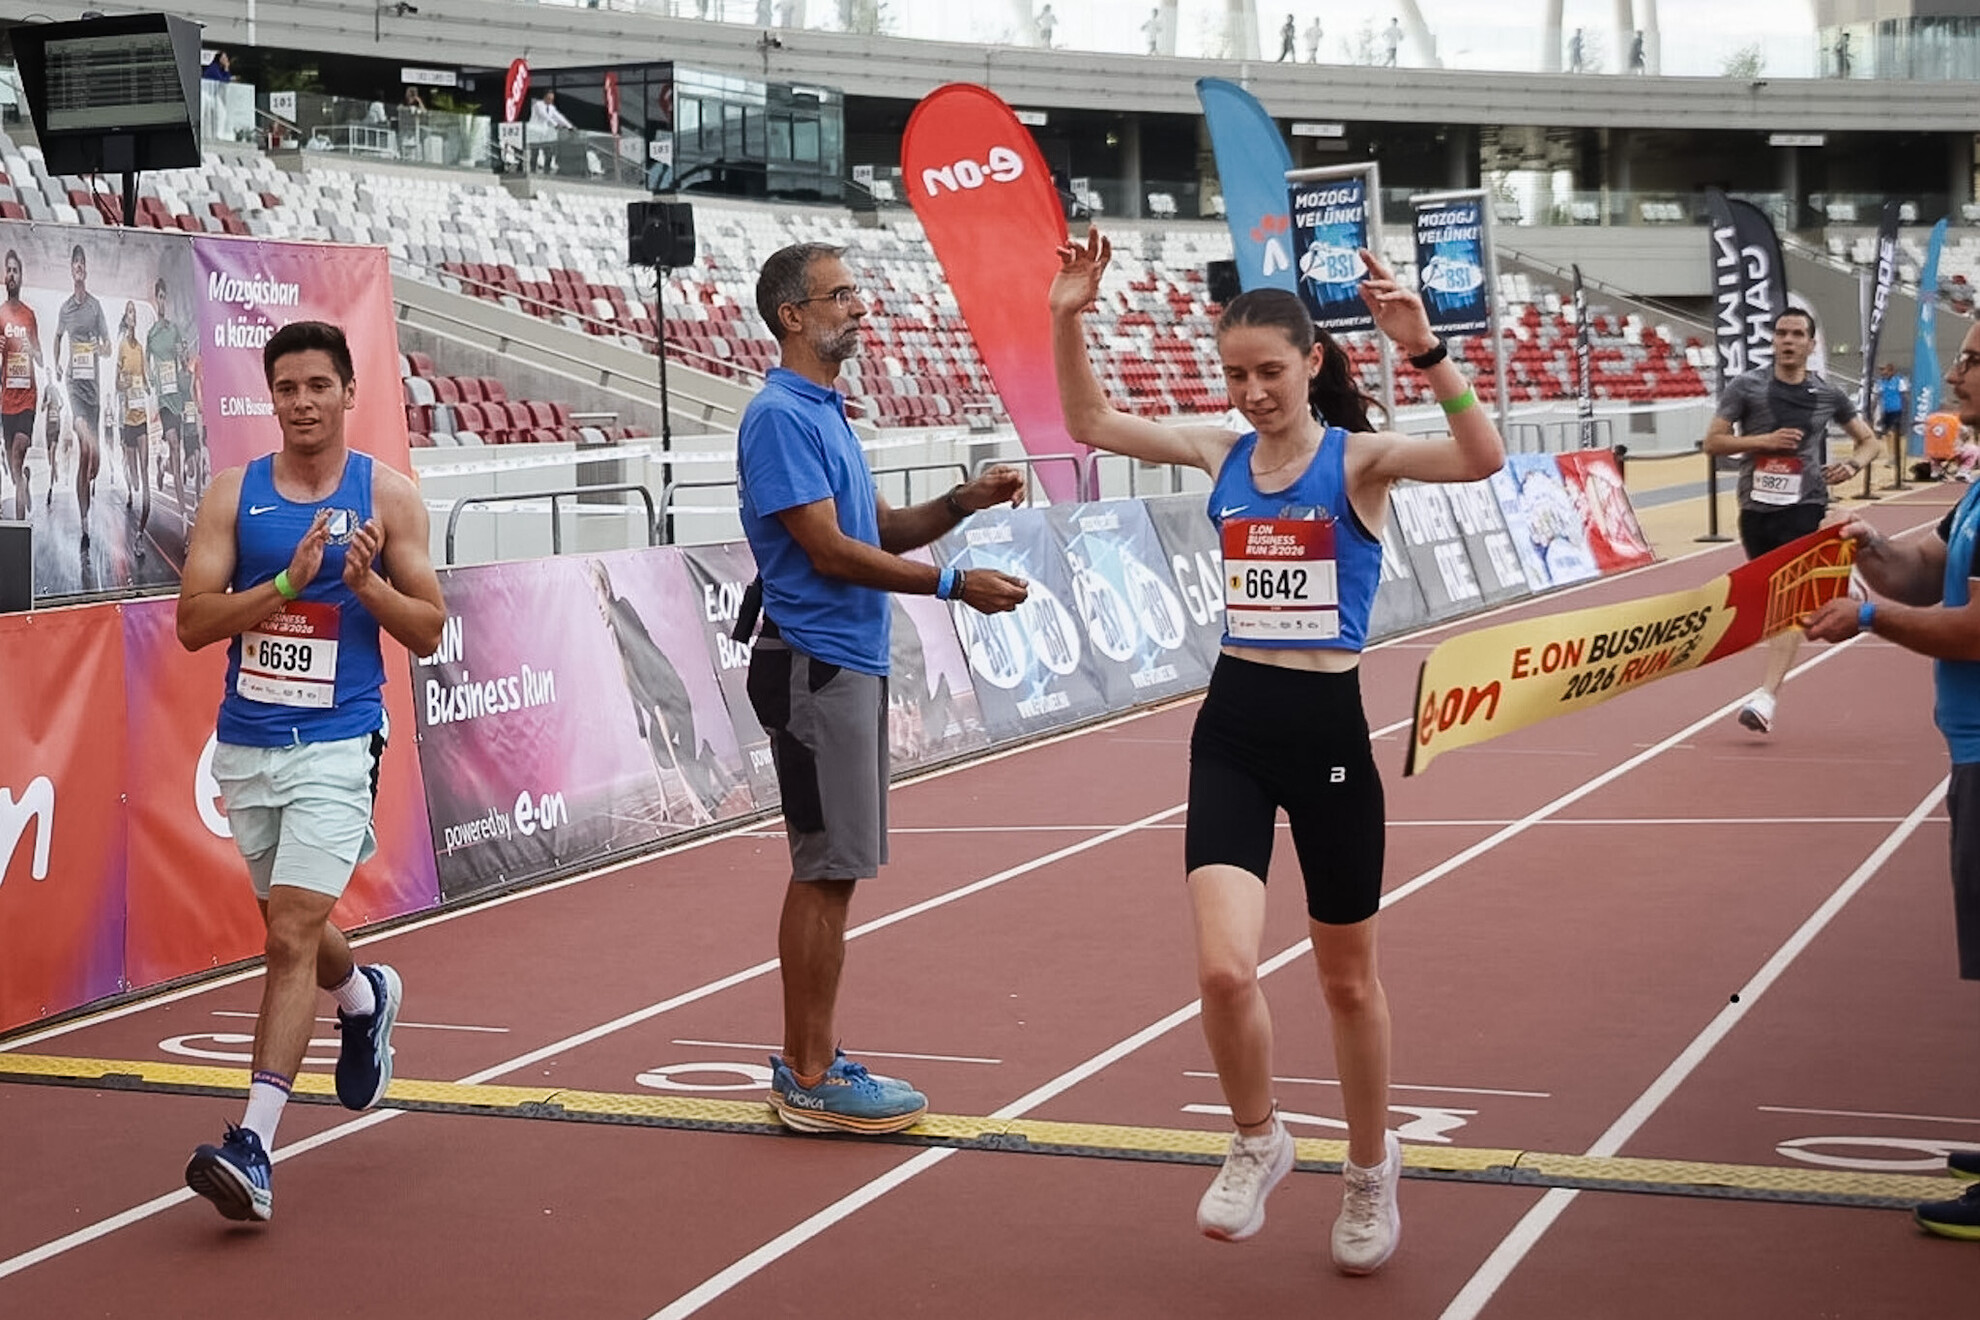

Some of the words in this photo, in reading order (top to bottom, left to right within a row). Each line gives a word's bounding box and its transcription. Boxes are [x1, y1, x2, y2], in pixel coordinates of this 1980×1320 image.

[1295, 189, 1358, 209] MOZOGJ
[1296, 207, 1362, 228] VELÜNK!
[1418, 210, 1474, 227] MOZOGJ
[1418, 226, 1478, 244] VELÜNK!
[1327, 254, 1354, 278] BSI
[1446, 267, 1472, 290] BSI
[209, 271, 300, 311] Mozgásban
[215, 323, 226, 347] a
[1762, 475, 1789, 490] 6827
[1247, 535, 1296, 545] BUSINESS
[1249, 524, 1273, 534] E.ON
[1245, 545, 1267, 555] RUN
[1246, 567, 1309, 600] 6642
[1511, 638, 1585, 680] E.ON
[1587, 606, 1712, 664] BUSINESS
[259, 641, 312, 672] 6639
[1560, 665, 1616, 702] 2026
[1617, 646, 1677, 687] RUN
[426, 671, 519, 725] Business
[521, 664, 556, 708] Run
[444, 808, 494, 856] powered
[493, 808, 511, 841] by
[788, 1090, 824, 1110] HOKA
